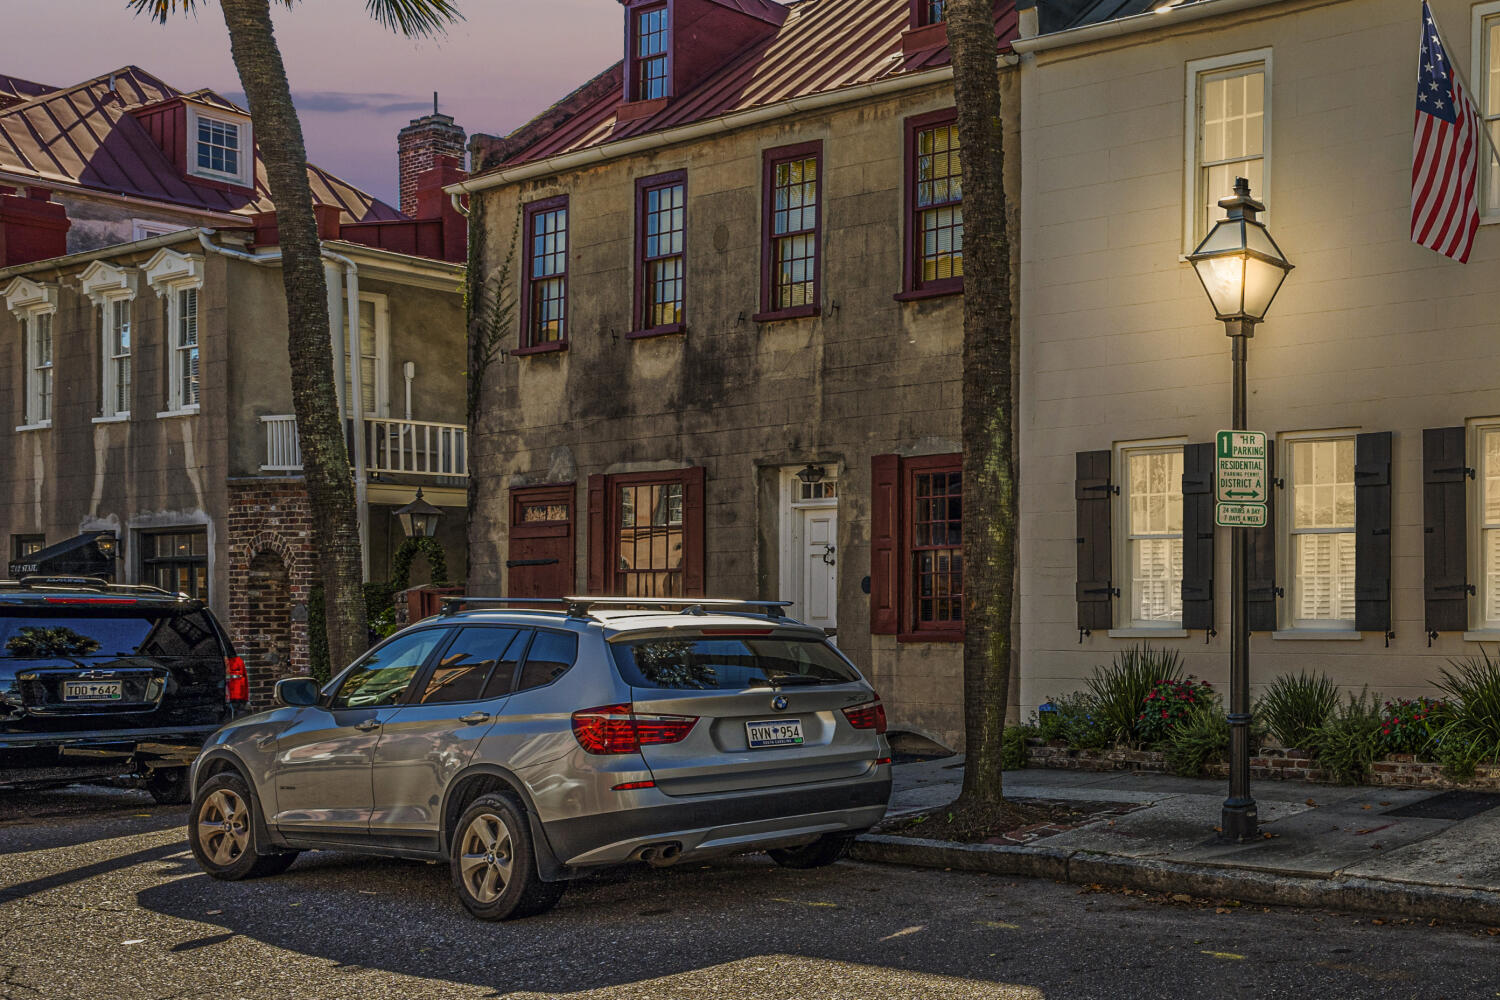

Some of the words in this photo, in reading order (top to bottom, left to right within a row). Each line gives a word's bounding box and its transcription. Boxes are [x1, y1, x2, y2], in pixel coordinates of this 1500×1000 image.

[1222, 436, 1228, 454] 1
[1242, 436, 1255, 444] HR
[1234, 447, 1264, 455] PARKING
[1221, 461, 1263, 470] RESIDENTIAL
[1221, 479, 1252, 488] DISTRICT
[1256, 479, 1262, 488] A
[97, 685, 118, 695] 642
[751, 728, 772, 740] RVN
[780, 725, 800, 738] 954
